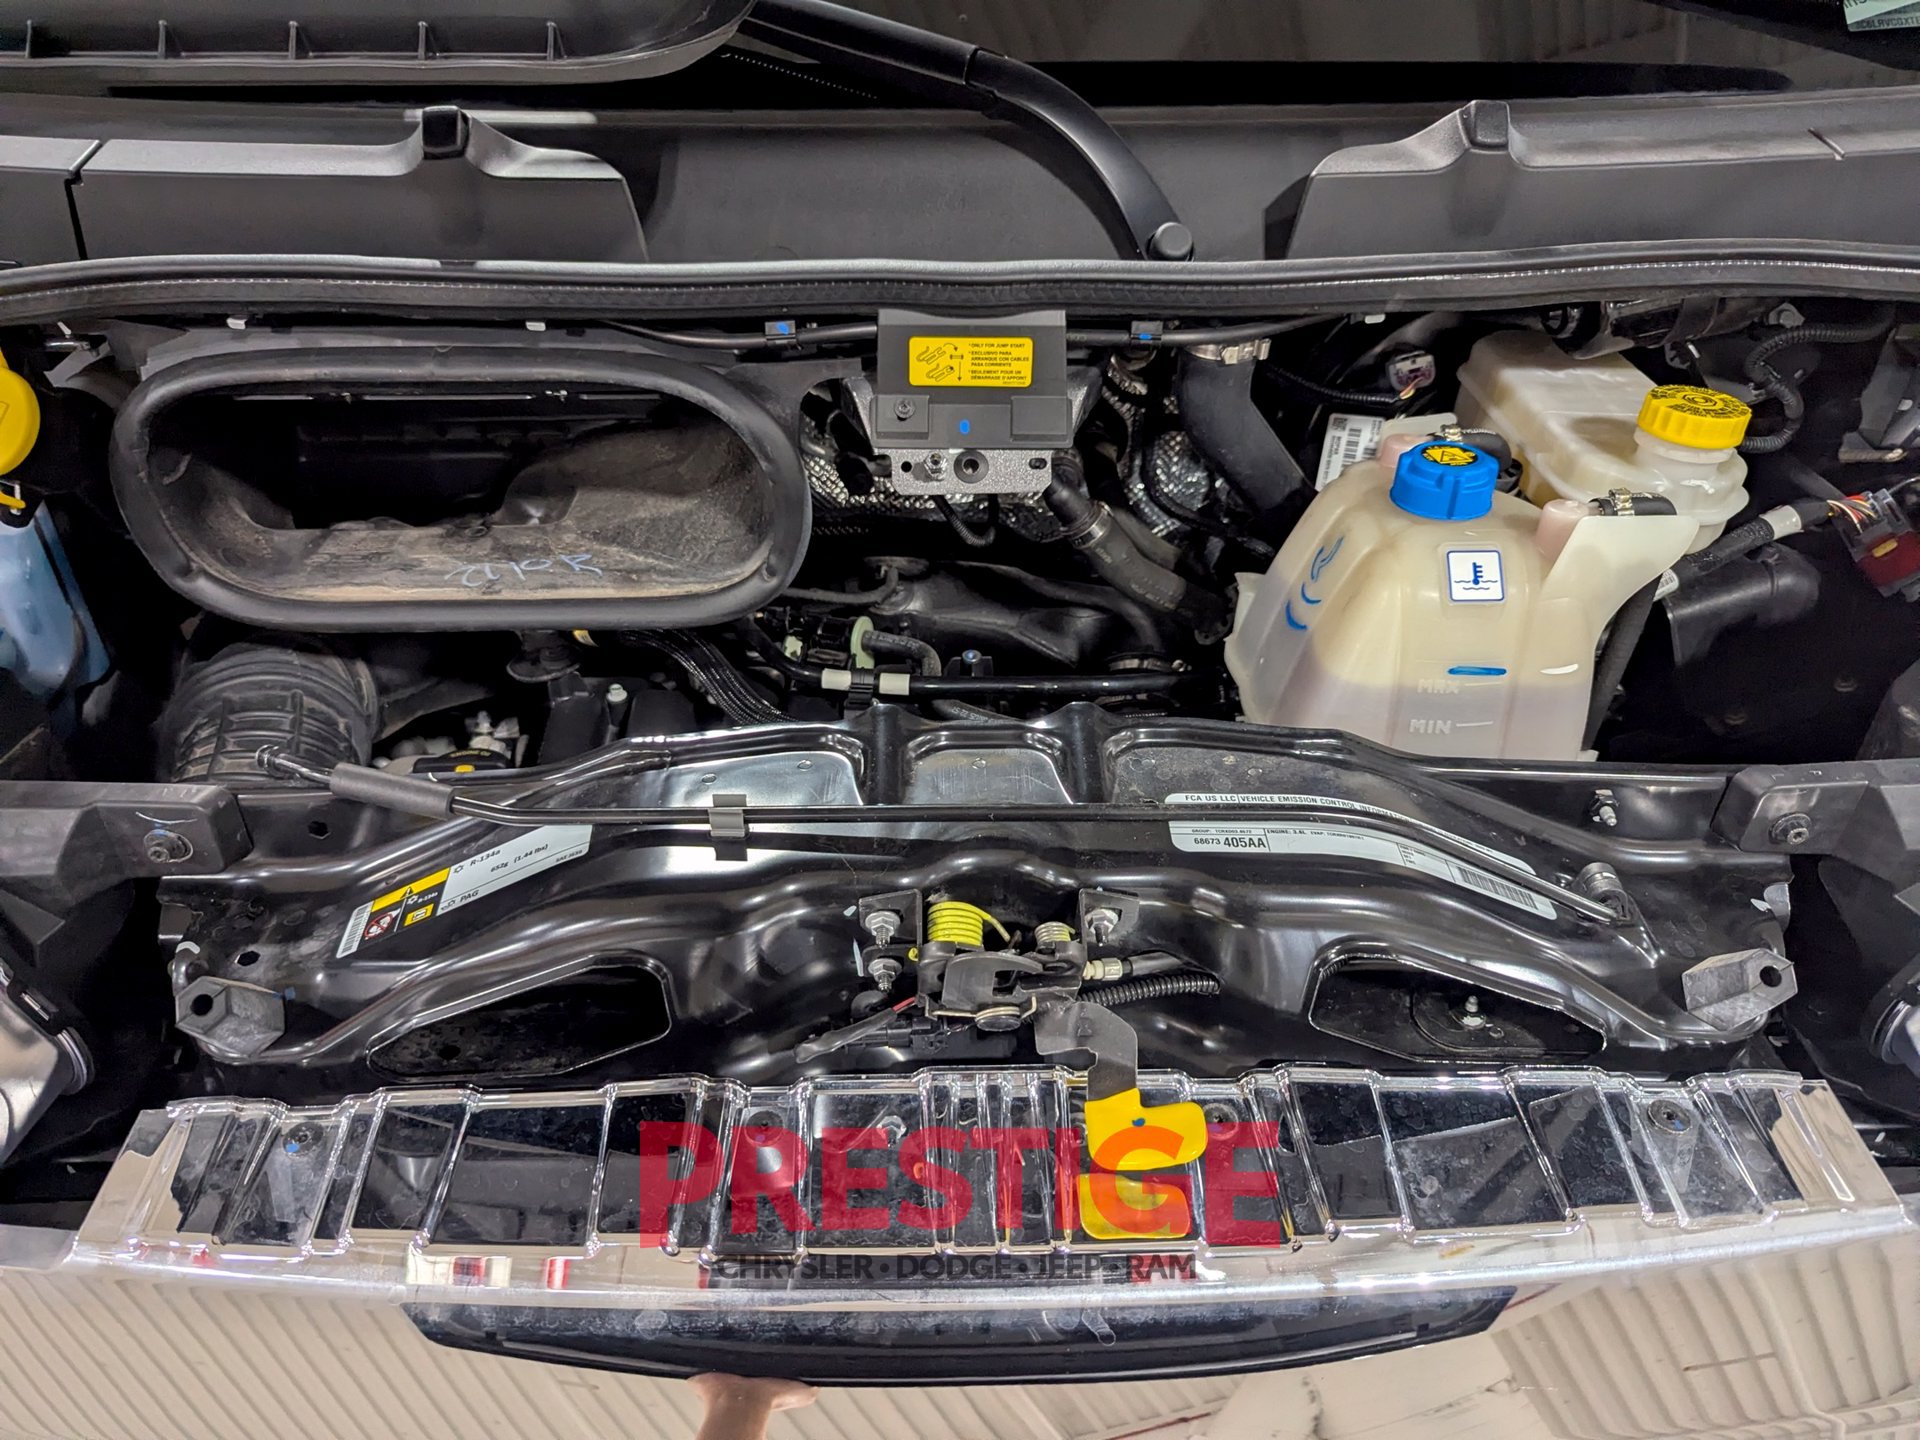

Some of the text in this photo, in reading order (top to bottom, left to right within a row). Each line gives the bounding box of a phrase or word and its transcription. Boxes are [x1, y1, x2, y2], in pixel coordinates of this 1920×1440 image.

[1409, 719, 1452, 734] MIN
[1277, 796, 1317, 804] EMISSION
[1320, 798, 1356, 809] CONTROL
[1223, 837, 1267, 848] 405AA
[469, 849, 501, 866] R-134a
[490, 861, 509, 873] 652g
[513, 850, 533, 863] (1.44
[460, 889, 480, 902] PAG
